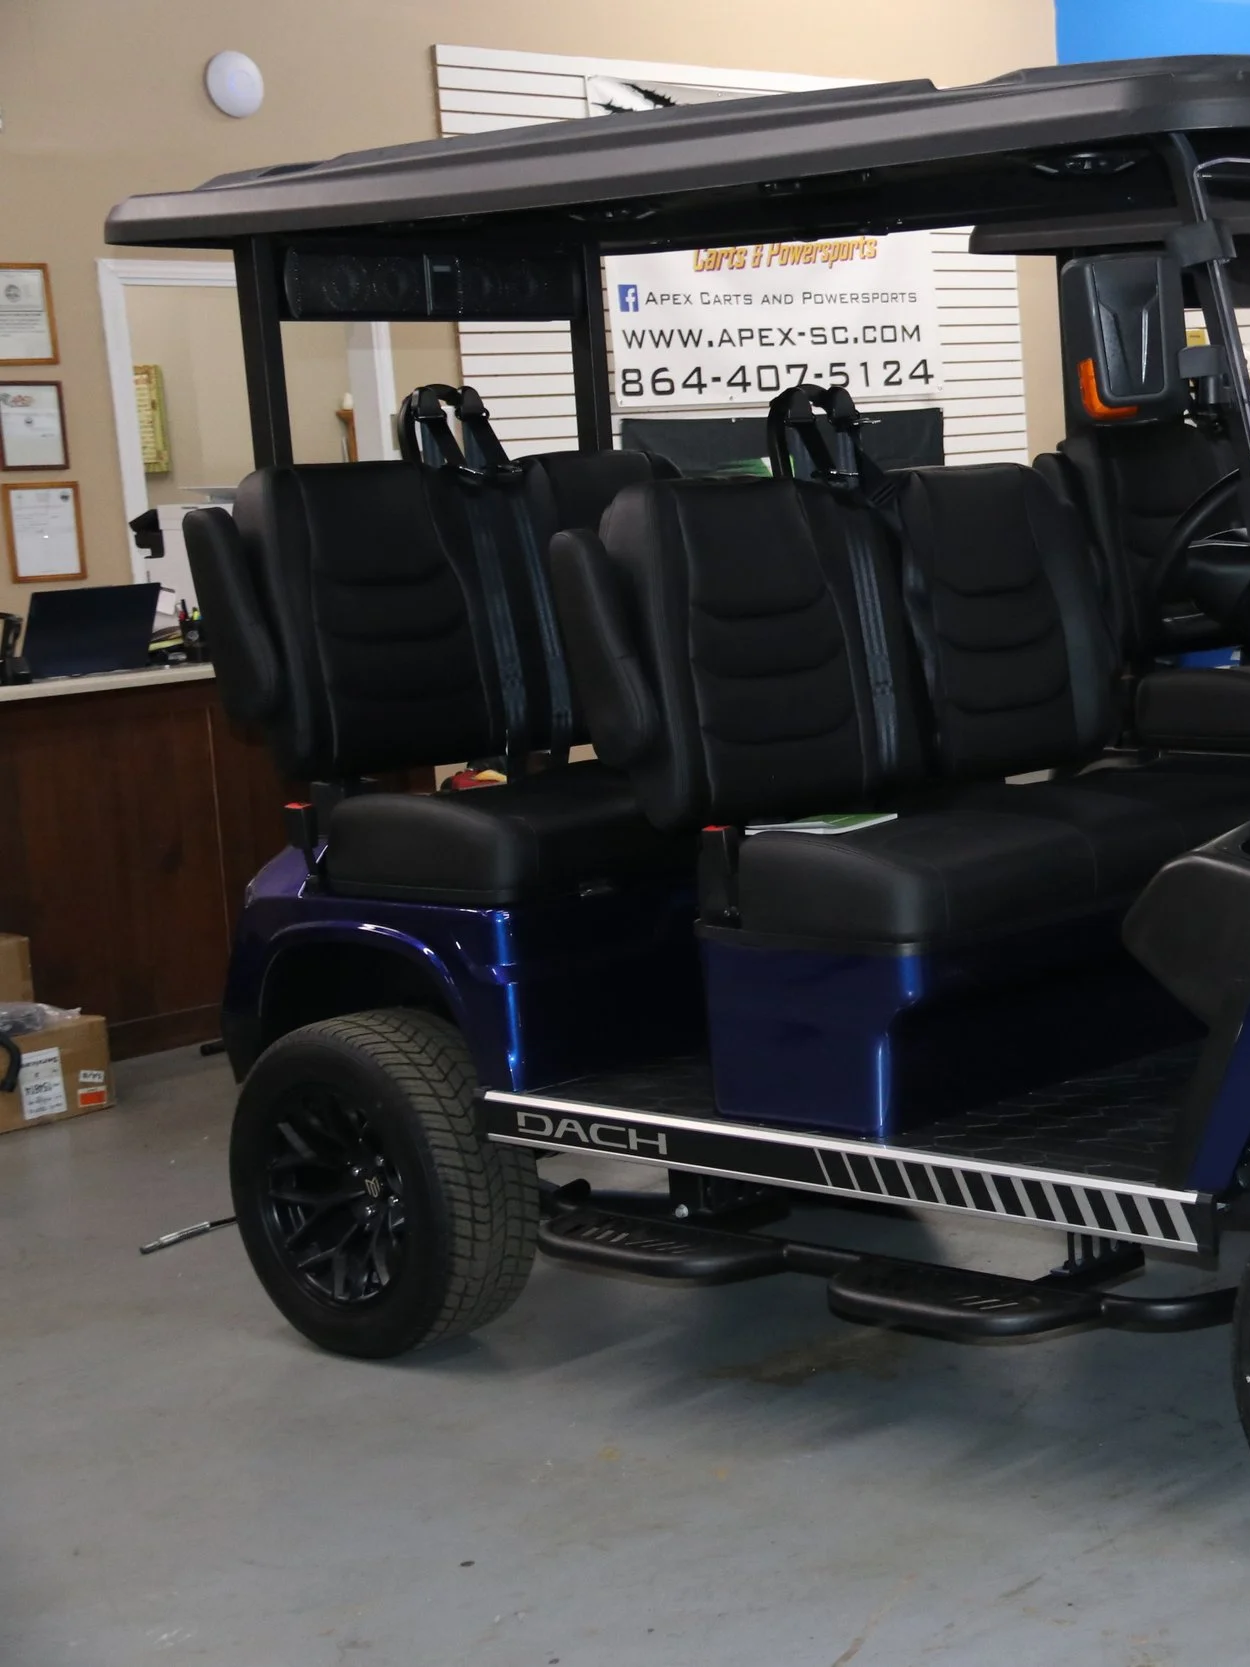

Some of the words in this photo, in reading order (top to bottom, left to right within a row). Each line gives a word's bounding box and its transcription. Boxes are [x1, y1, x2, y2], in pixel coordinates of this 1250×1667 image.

[768, 236, 877, 267] Powersports
[622, 324, 921, 350] WWW.APEX-SC.COM
[621, 359, 934, 398] 864-407-5124
[516, 1111, 668, 1155] DACH
